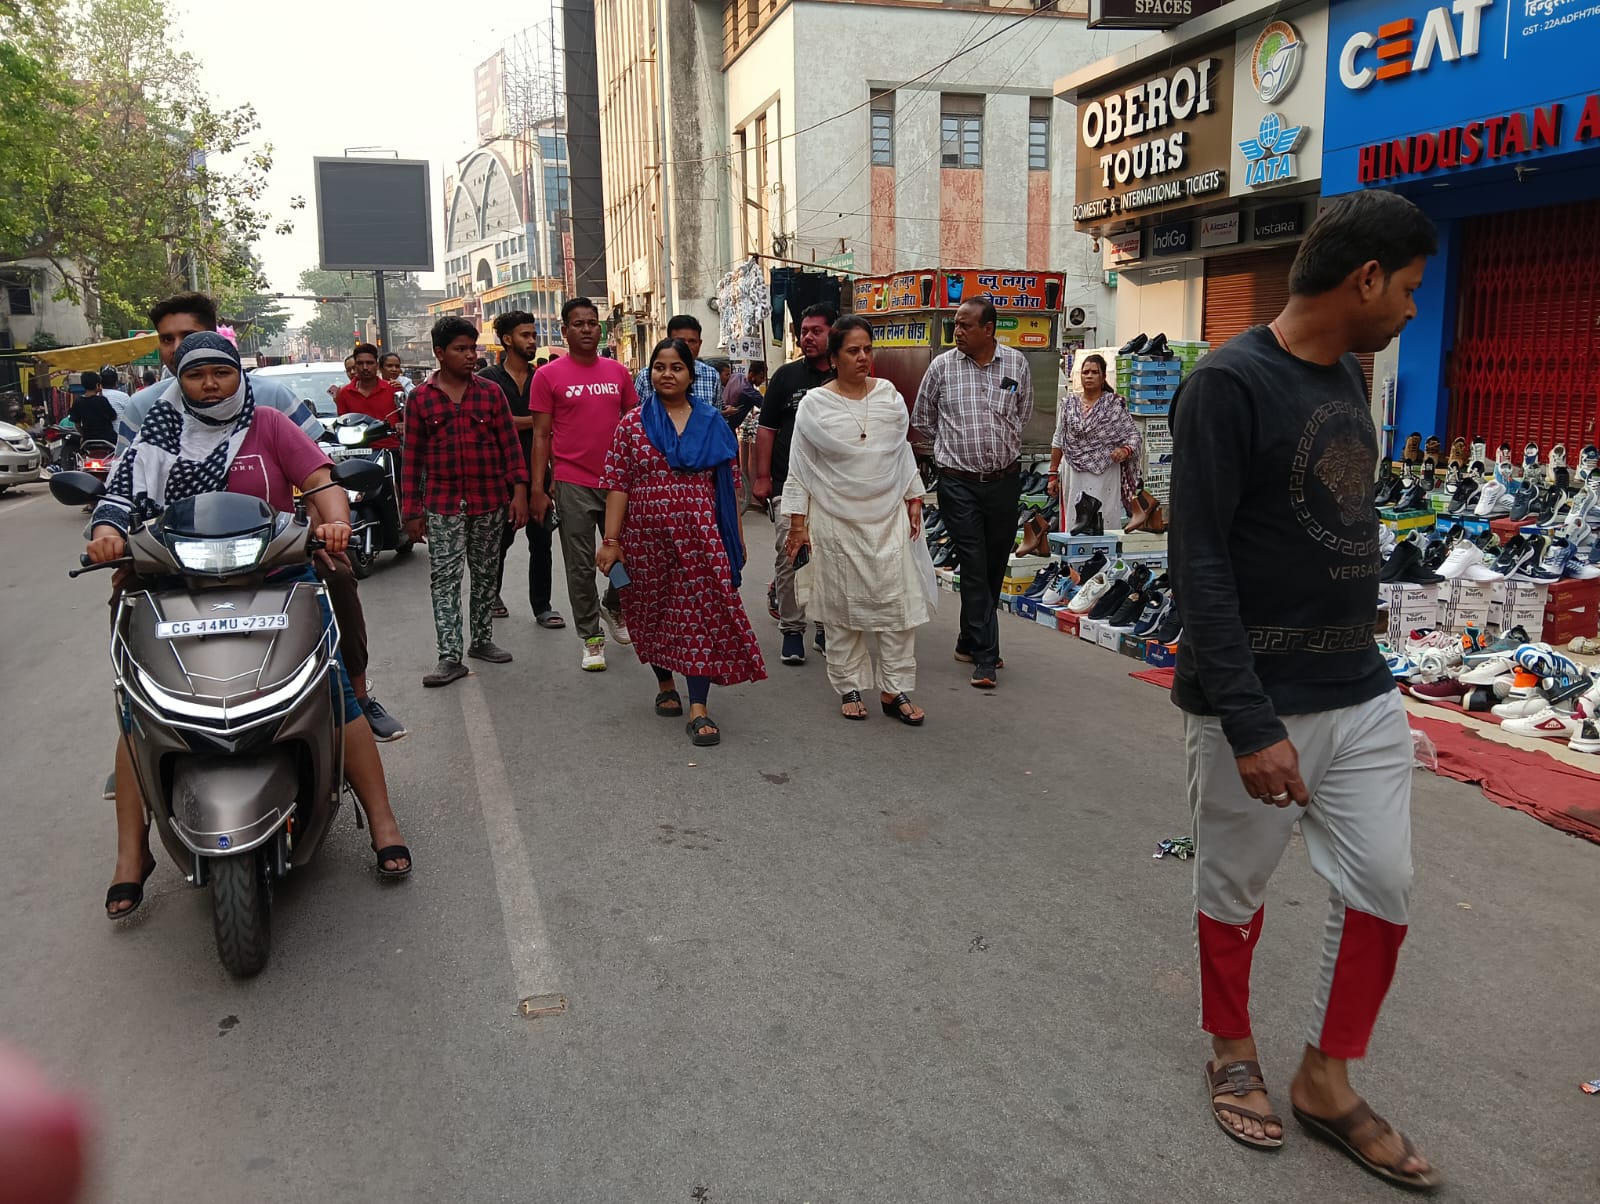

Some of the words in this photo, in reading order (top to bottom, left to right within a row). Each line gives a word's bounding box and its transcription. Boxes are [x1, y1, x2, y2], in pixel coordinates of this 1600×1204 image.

[1135, 0, 1192, 14] SPACES
[1522, 24, 1539, 36] GST
[1339, 0, 1493, 89] CEAT
[1082, 58, 1211, 148] OBEROI
[1358, 103, 1563, 183] HINDUSTAN
[1100, 132, 1183, 188] TOURS
[1244, 153, 1292, 187] IATA
[1073, 198, 1107, 221] DOMESTIC
[1110, 197, 1116, 211] &
[1120, 180, 1181, 209] INTERNATIONAL
[1186, 170, 1220, 194] TICKETS
[1153, 230, 1186, 249] IndiGo
[586, 383, 620, 395] YONEX
[230, 464, 255, 472] ORK
[1329, 562, 1380, 580] VERSAC
[171, 622, 191, 635] CG
[247, 615, 286, 629] 7379
